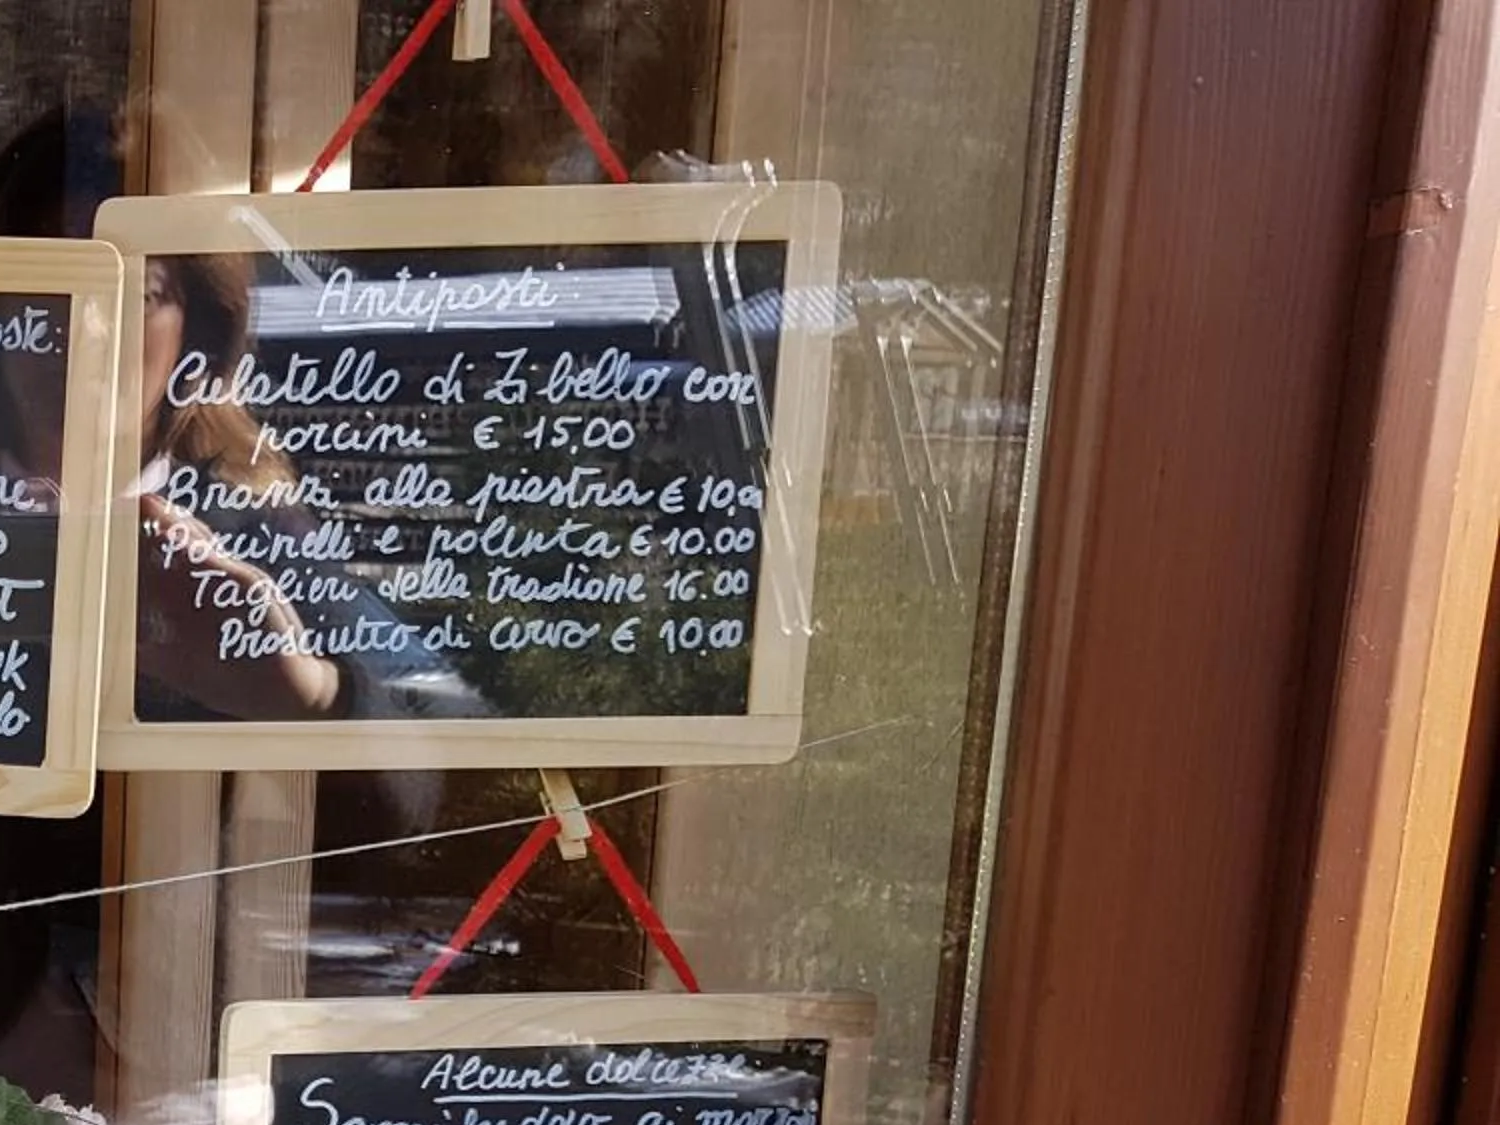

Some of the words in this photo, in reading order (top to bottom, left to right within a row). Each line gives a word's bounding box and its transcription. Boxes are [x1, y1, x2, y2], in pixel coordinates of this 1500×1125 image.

[425, 353, 475, 404] di
[253, 415, 427, 464] porcini
[474, 418, 502, 452] €
[365, 463, 455, 509] alla
[467, 467, 654, 522] piastra
[659, 476, 687, 514] €
[374, 525, 404, 555] e
[630, 525, 653, 557] €
[660, 526, 756, 556] 10.00
[423, 613, 475, 651] di
[610, 616, 642, 653] €
[421, 1054, 573, 1090] Alcune
